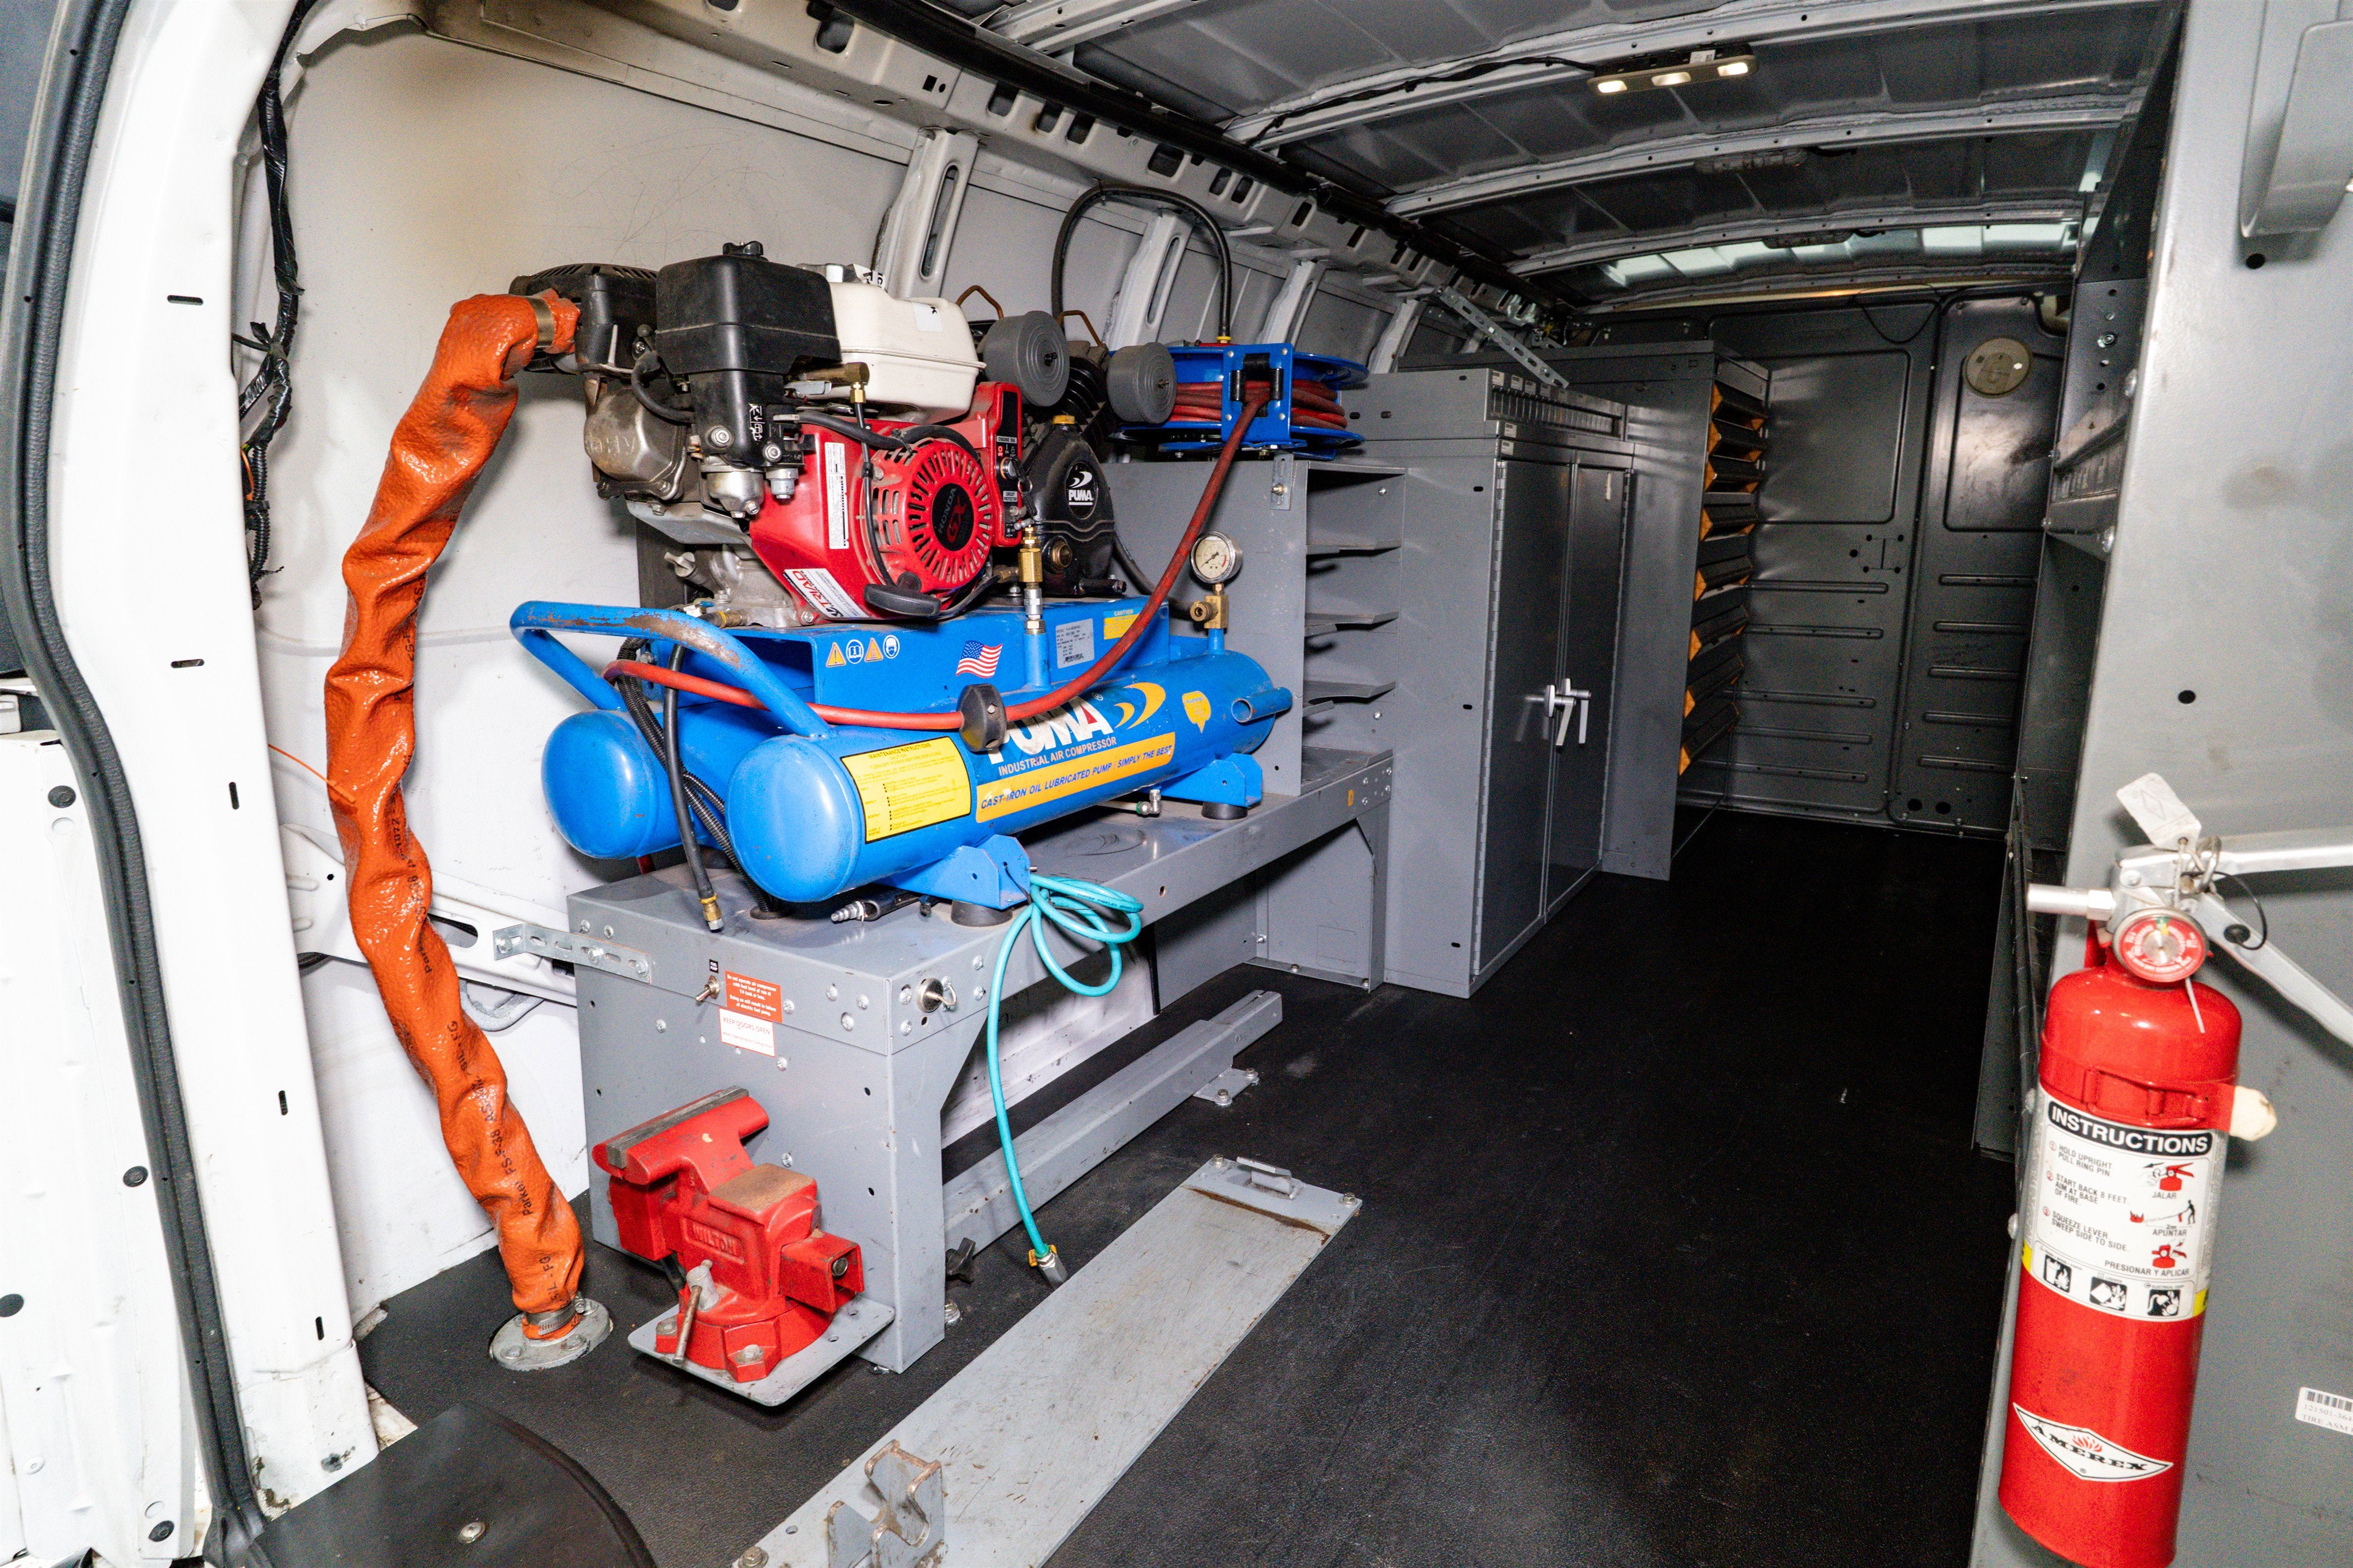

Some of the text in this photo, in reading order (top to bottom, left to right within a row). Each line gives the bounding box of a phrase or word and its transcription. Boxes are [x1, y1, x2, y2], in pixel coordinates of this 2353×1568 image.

[1069, 489, 1093, 501] PUMA
[938, 488, 956, 534] HONDA
[947, 496, 967, 543] GX
[792, 570, 828, 608] TRIAD
[800, 570, 834, 607] TECHNOLOGIES
[868, 743, 931, 759] MAINTENANCE INSTRUCTIONS
[998, 736, 1117, 777] INDUSTRIAL AIR COMPRESSOR
[981, 794, 1004, 809] CAST
[1005, 787, 1027, 802] IRON
[1029, 783, 1042, 794] OIL
[1044, 768, 1091, 790] LUBRICATED
[1092, 762, 1112, 776] PUMP
[1117, 755, 1141, 768] SIMPLY
[1143, 751, 1155, 761] THE
[1156, 744, 1172, 756] BEST
[757, 983, 777, 992] compressor
[736, 1021, 755, 1030] DOORS
[755, 1026, 770, 1034] OPEN
[2051, 1106, 2208, 1153] INSTRUCTIONS
[489, 1129, 516, 1175] FS-F-38
[2059, 1144, 2077, 1158] HOLD
[2058, 1152, 2111, 1177] PULL RING PIN
[2054, 1188, 2063, 1196] OF
[2055, 1181, 2099, 1204] AIM AT BASE
[2056, 1173, 2077, 1188] START
[2078, 1183, 2099, 1196] BACK
[2151, 1191, 2177, 1200] JALAR
[515, 1180, 534, 1216] Parker
[2051, 1218, 2074, 1234] SWEEP
[2076, 1229, 2093, 1242] SIDE
[2096, 1237, 2106, 1246] TO
[2052, 1210, 2082, 1230] SQUEEZE
[692, 1222, 737, 1257] WILTON
[2152, 1229, 2187, 1237] APUNTAR
[2104, 1260, 2151, 1276] PRESIONAR
[2161, 1268, 2190, 1277] APLICAR
[2302, 1413, 2323, 1424] TIRE
[2327, 1421, 2348, 1432] ASM
[2032, 1424, 2147, 1470] AMEREX
